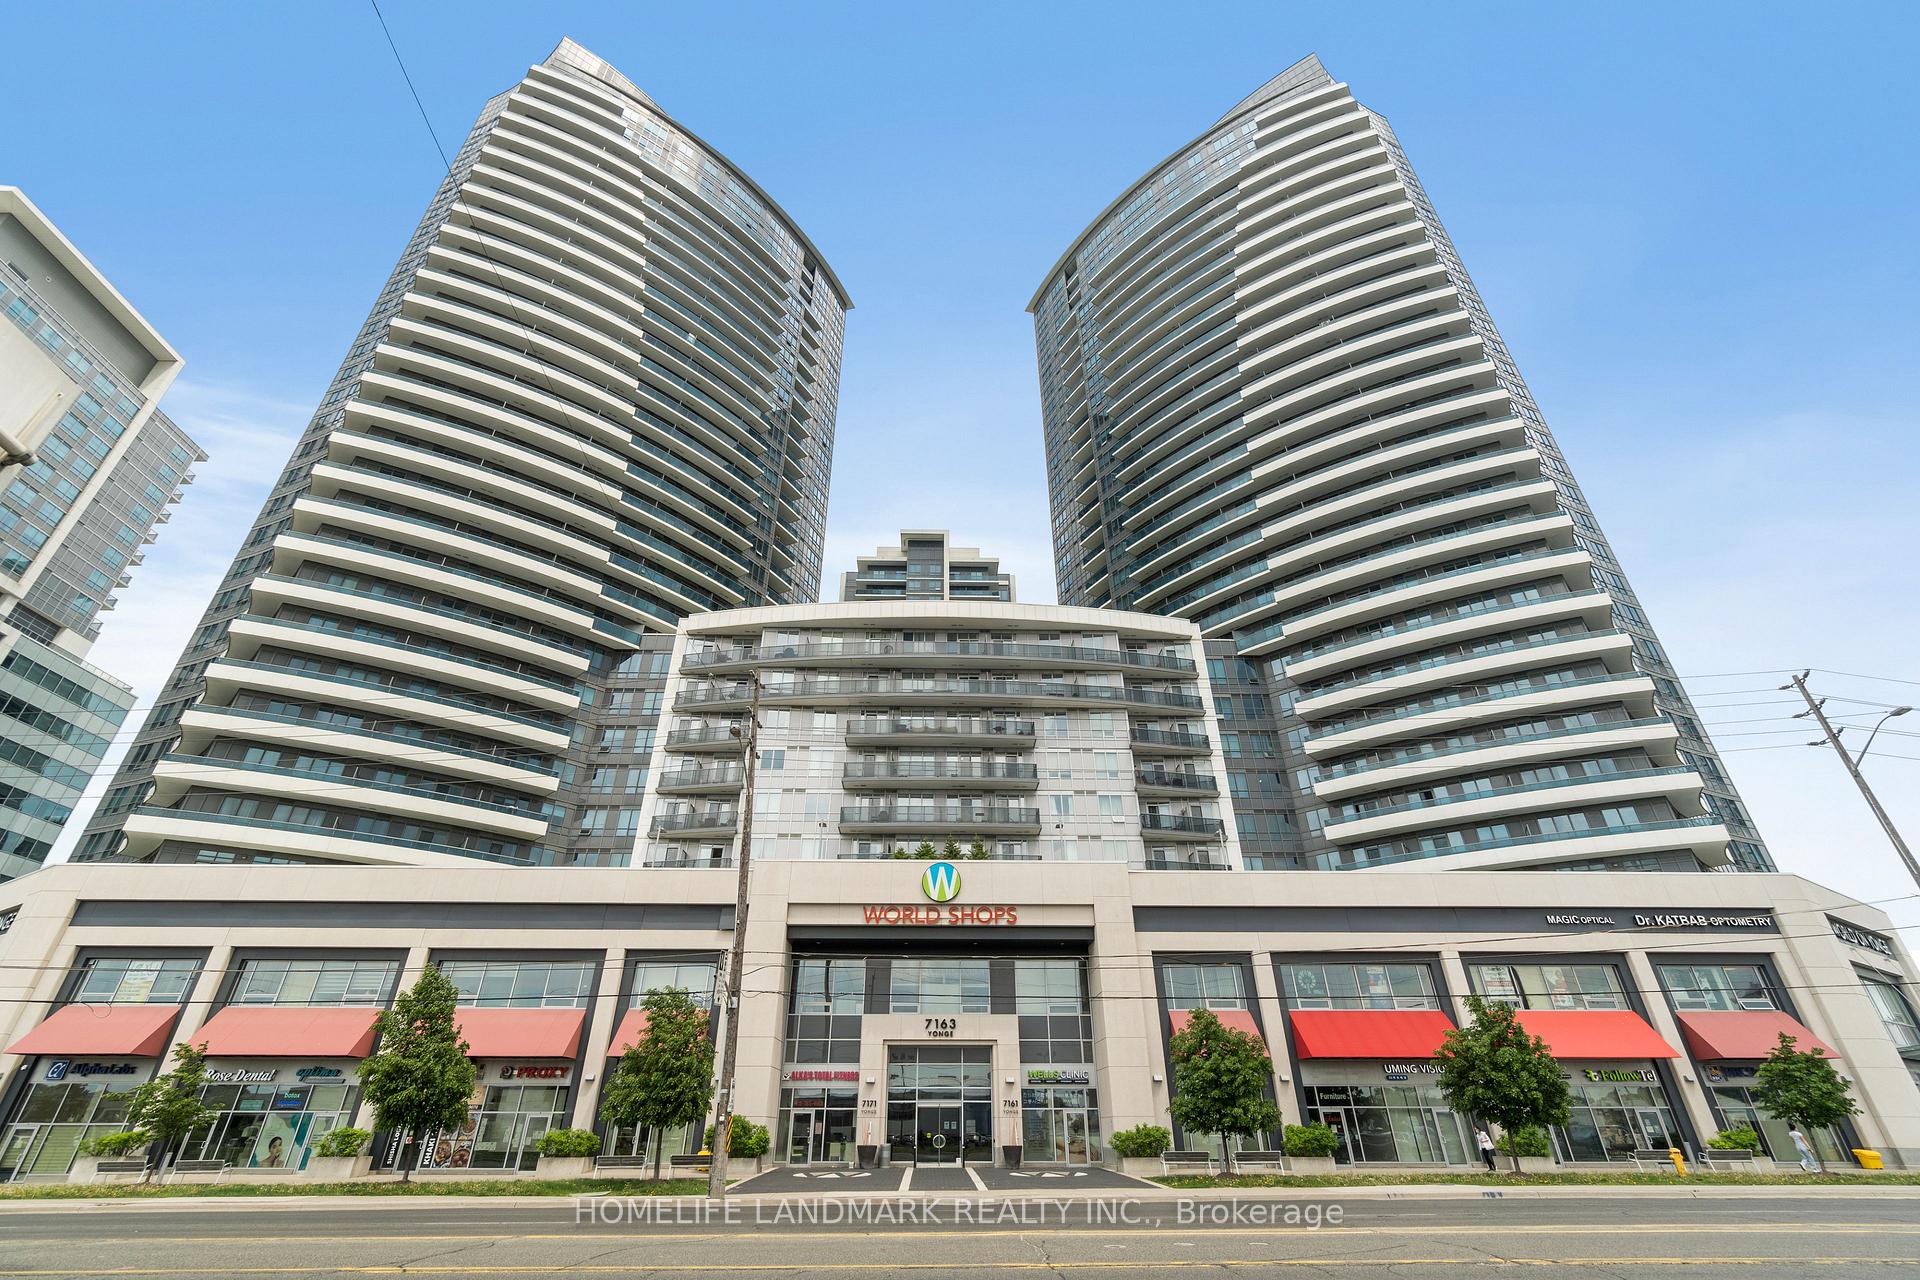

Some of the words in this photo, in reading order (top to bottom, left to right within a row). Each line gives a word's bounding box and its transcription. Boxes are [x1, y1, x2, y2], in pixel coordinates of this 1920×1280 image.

[863, 905, 941, 925] WORLD
[948, 905, 1018, 925] SHOPS
[1546, 915, 1580, 924] MAGIC
[1580, 916, 1616, 924] OPTICAL
[1654, 915, 1707, 926] KATBAB
[1709, 917, 1772, 926] OPTOMETRY
[925, 1018, 956, 1030] 7163
[205, 1068, 231, 1081] Rose
[233, 1067, 277, 1082] Dental
[516, 1066, 570, 1079] PROXY
[1027, 1070, 1059, 1079] WELLS
[1060, 1070, 1089, 1079] CLINIC
[1383, 1064, 1418, 1074] UMING
[1419, 1064, 1447, 1074] VISIO
[1600, 1069, 1658, 1082] FollowTel
[1319, 1092, 1347, 1100] Furniture
[1003, 1100, 1019, 1108] 7161
[386, 1139, 399, 1165] SHISHA
[423, 1138, 436, 1165] KHAKI
